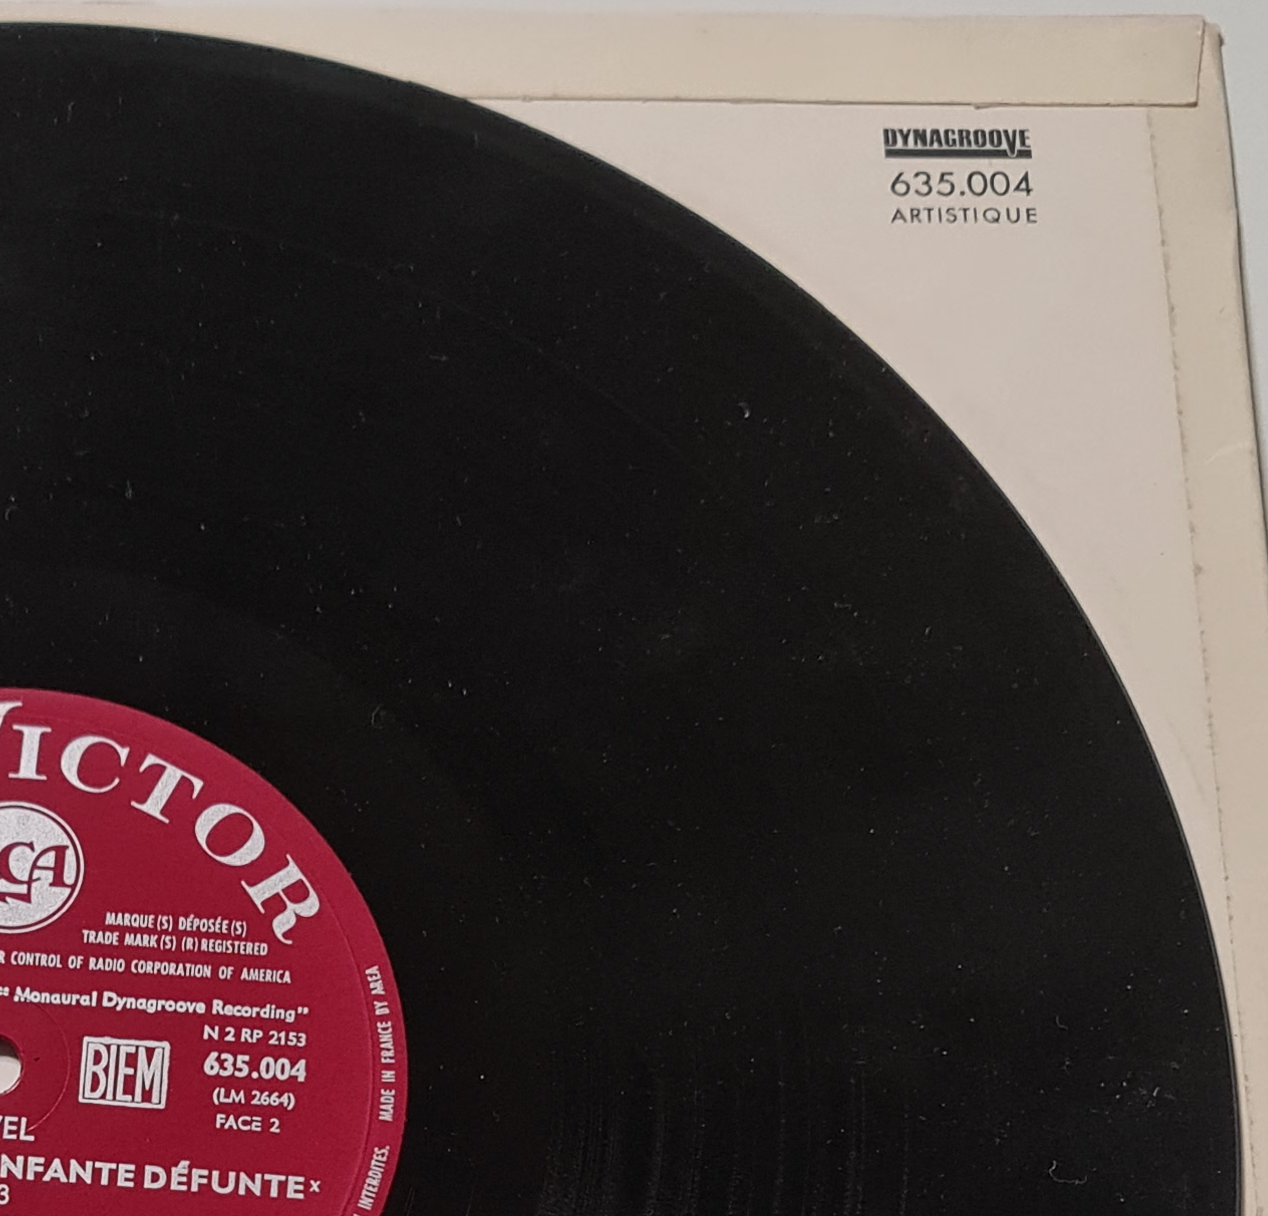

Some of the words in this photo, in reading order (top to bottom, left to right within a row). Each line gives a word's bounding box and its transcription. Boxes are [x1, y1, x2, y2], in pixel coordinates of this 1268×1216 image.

[883, 128, 1032, 158] DYNAGROOVE
[890, 170, 1034, 198] 635.004
[890, 206, 1038, 225] ARTISTIQUE
[81, 929, 120, 946] TRADE
[10, 950, 63, 968] CONTROL
[67, 955, 84, 969] OF
[88, 956, 126, 973] RADIO
[130, 959, 212, 979] CORPORATION
[218, 965, 235, 980] OF
[240, 967, 292, 984] AMERICA
[365, 965, 386, 996] AREA
[101, 990, 206, 1015] Dynagroove
[373, 1000, 390, 1016] BY
[202, 1024, 220, 1041] N
[223, 1026, 236, 1042] 2
[240, 1027, 264, 1044] RP
[268, 1030, 307, 1048] 2153
[376, 1021, 396, 1064] FRANCE
[82, 1042, 164, 1104] BIEM
[203, 1051, 307, 1083] 635.004
[381, 1070, 396, 1082] IN
[212, 1087, 246, 1106] (LM
[250, 1089, 296, 1111] 2664)
[378, 1088, 396, 1122] MADE
[215, 1113, 262, 1132] FACE
[269, 1117, 281, 1134] 2
[143, 1159, 306, 1200] DÉFUNTE
[357, 1145, 391, 1211] INTERDITES.
